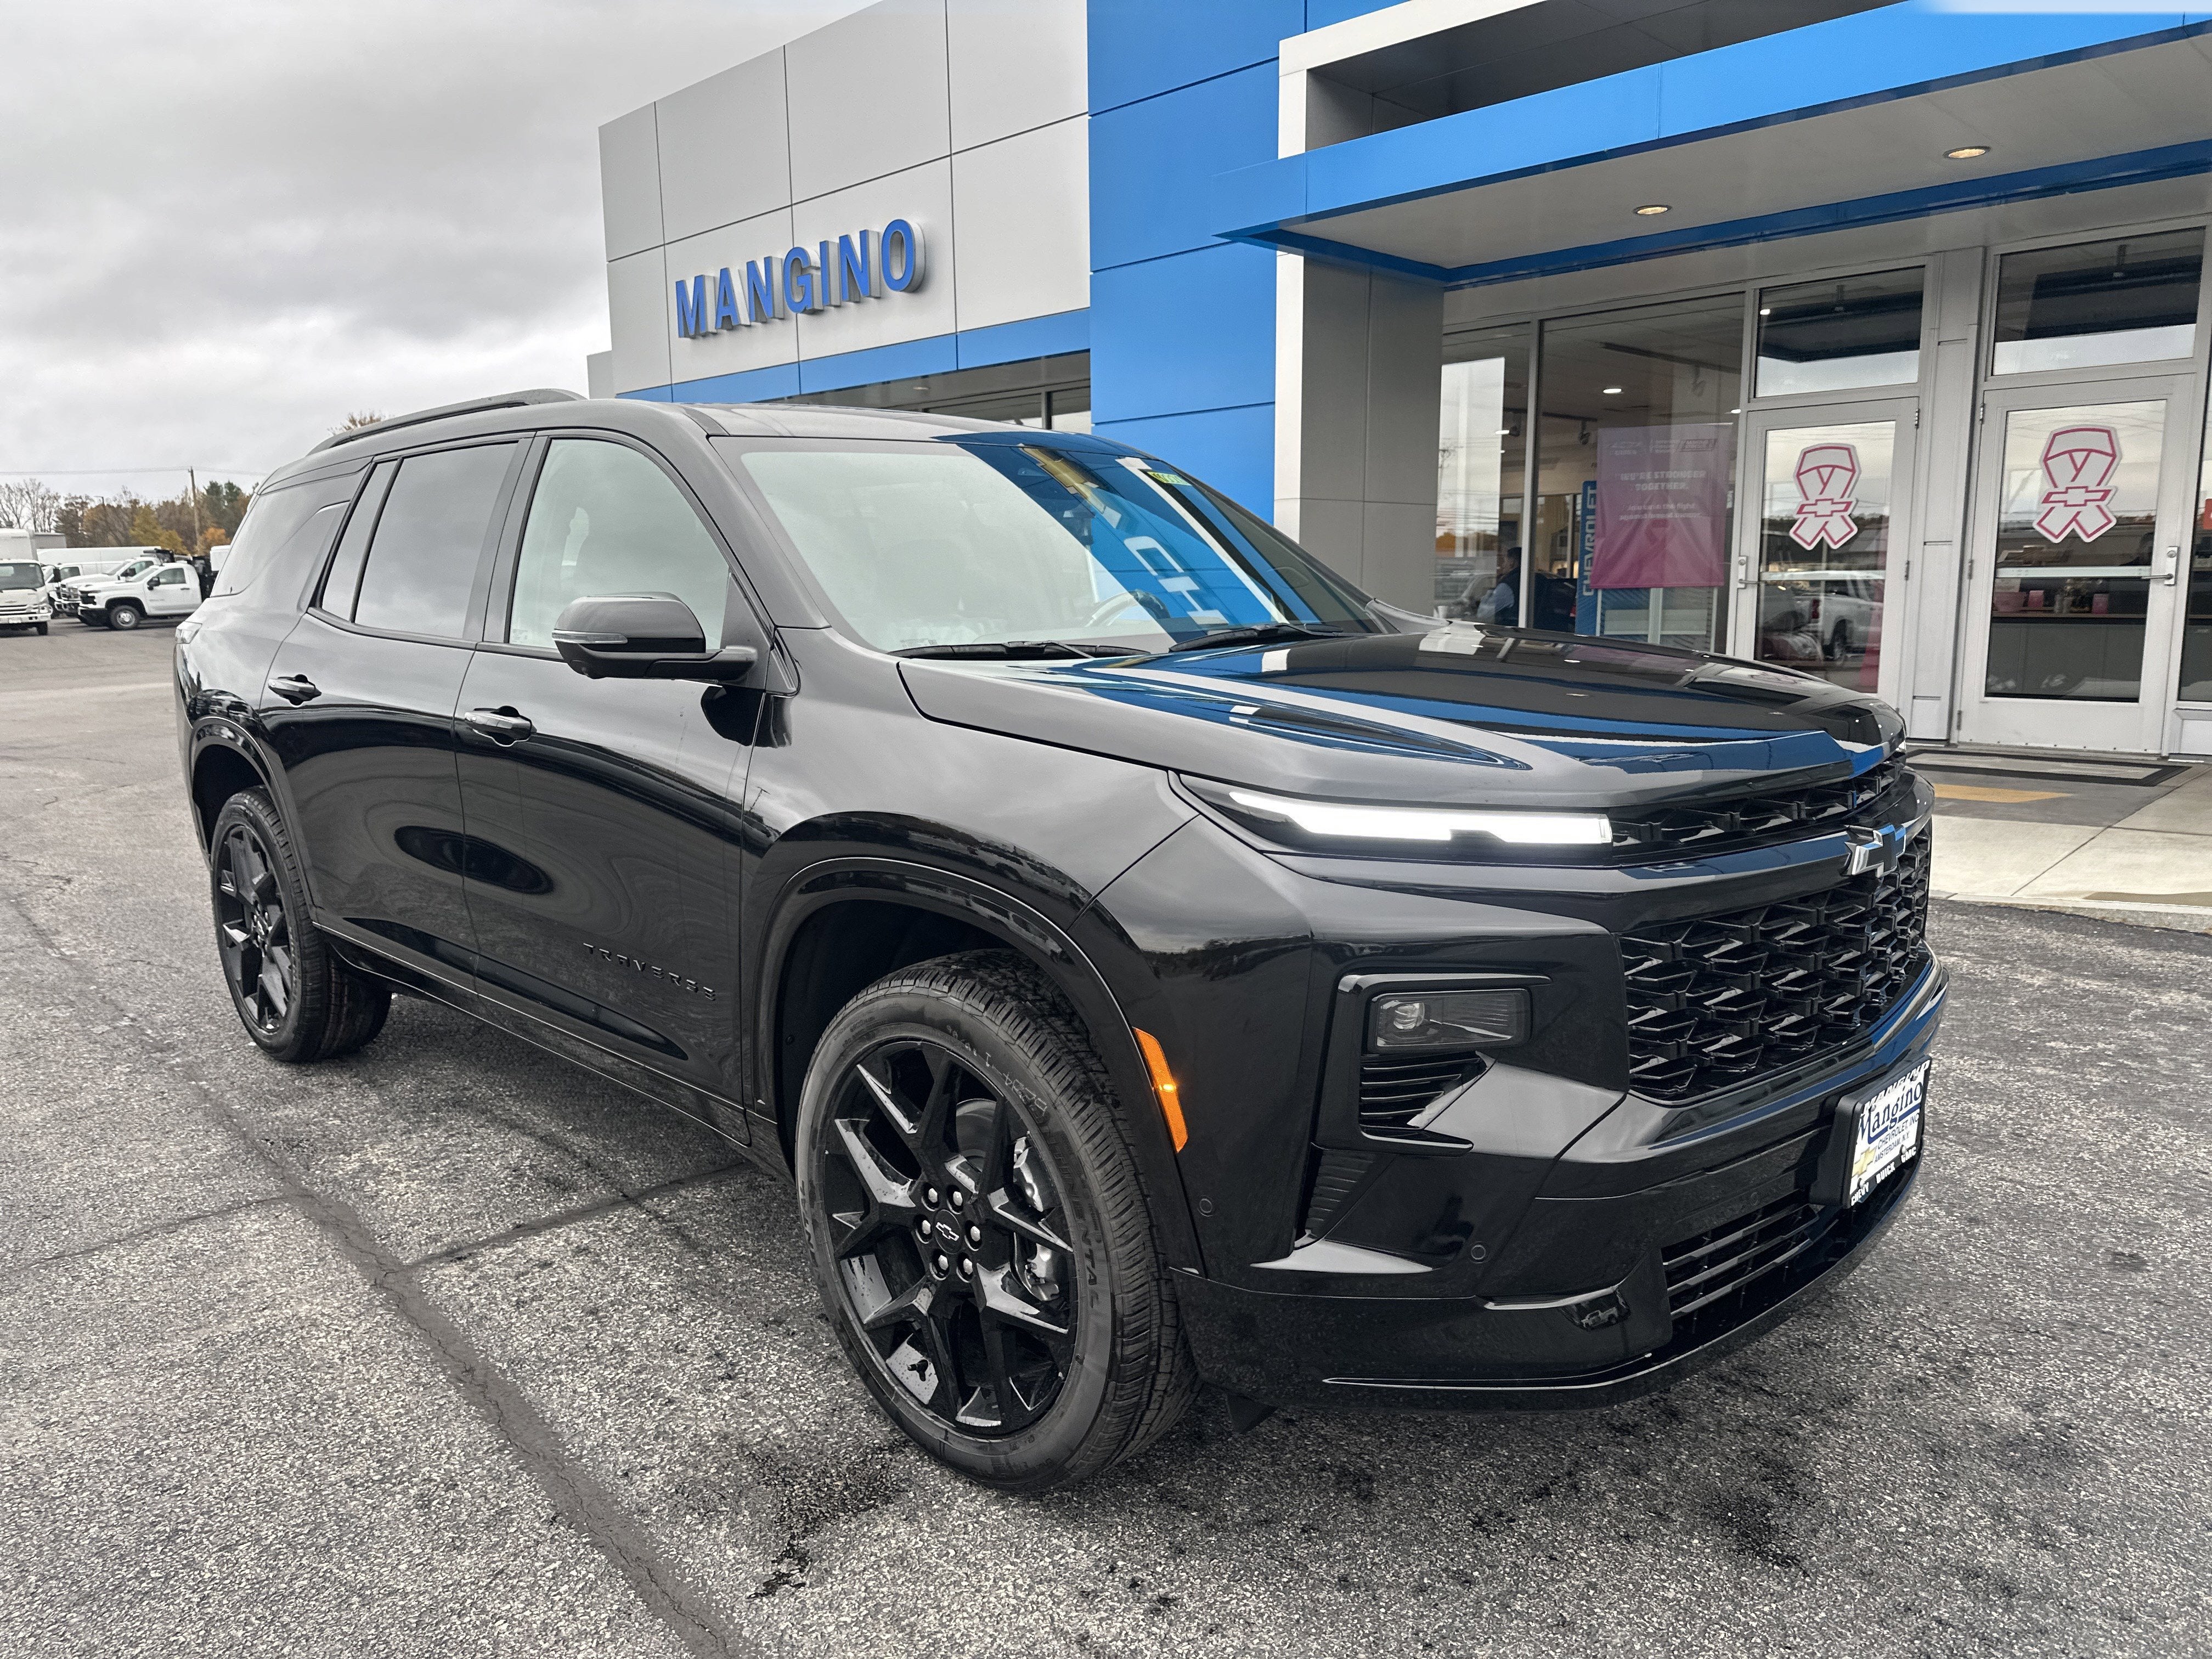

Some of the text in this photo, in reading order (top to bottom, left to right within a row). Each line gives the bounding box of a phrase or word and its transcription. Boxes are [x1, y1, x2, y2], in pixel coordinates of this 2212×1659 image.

[675, 218, 924, 338] MANGINO
[583, 942, 716, 1001] TRAVERSE
[1858, 1081, 1923, 1143] Mangino
[1851, 1146, 1916, 1206] CHEVY BUICK GMC
